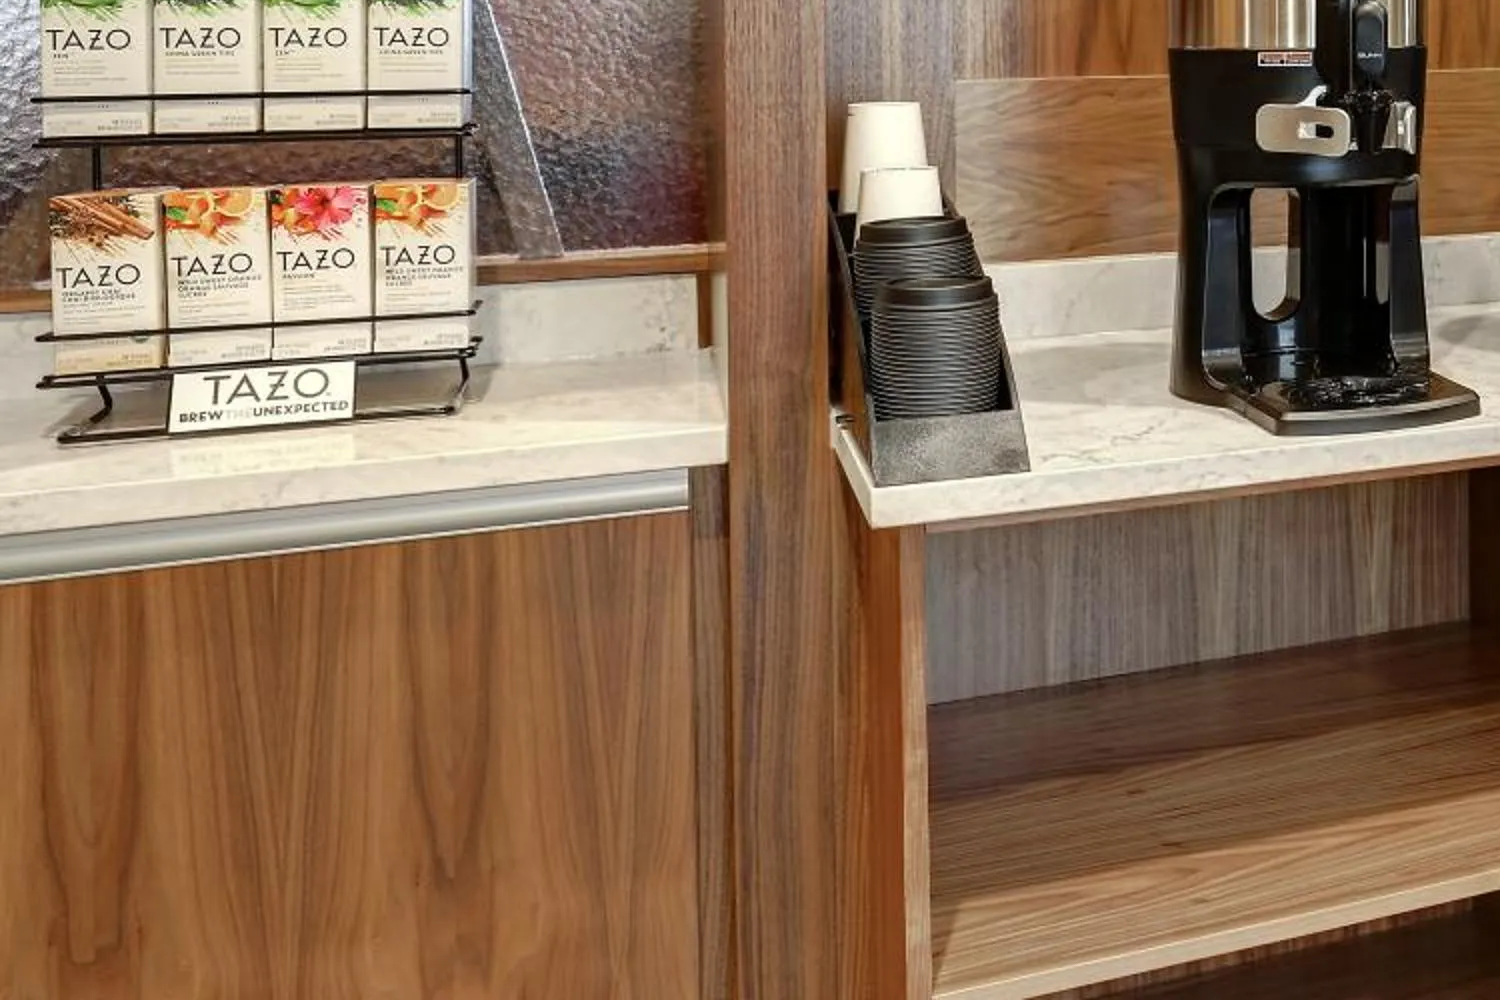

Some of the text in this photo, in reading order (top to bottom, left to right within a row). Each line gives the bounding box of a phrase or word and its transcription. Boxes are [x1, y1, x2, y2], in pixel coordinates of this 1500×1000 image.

[45, 28, 132, 51] TAZO
[159, 27, 242, 50] TAZO
[268, 27, 348, 48] TAZO
[372, 26, 450, 48] TAZO
[170, 252, 253, 278] TAZO
[276, 247, 355, 272] TAZO
[380, 244, 456, 267] TAZO
[56, 263, 141, 289] TAZO
[202, 367, 330, 406] TAZO
[178, 409, 225, 424] BREW
[252, 399, 350, 418] UNEXPECTED
